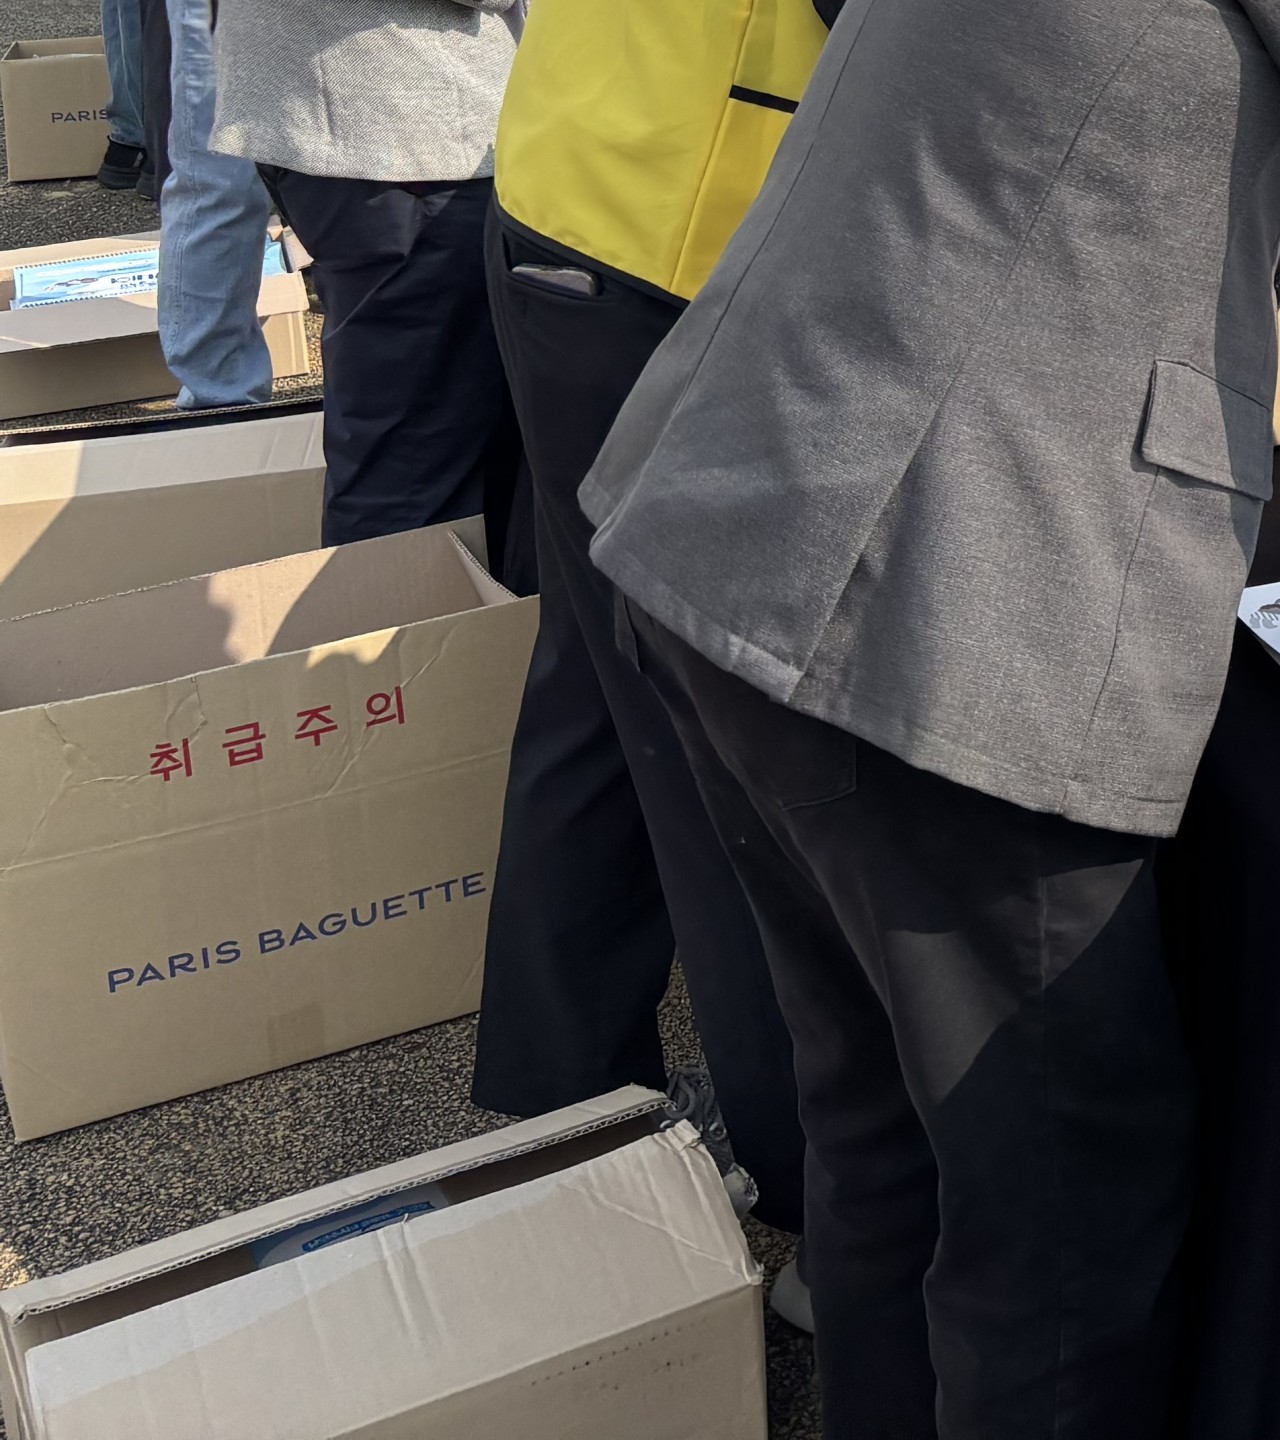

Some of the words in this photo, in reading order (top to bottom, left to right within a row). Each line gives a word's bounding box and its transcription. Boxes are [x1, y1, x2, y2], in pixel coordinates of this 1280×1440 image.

[51, 109, 108, 123] PARIS
[107, 939, 242, 994] PARIS
[257, 871, 488, 956] BAGUETTE
